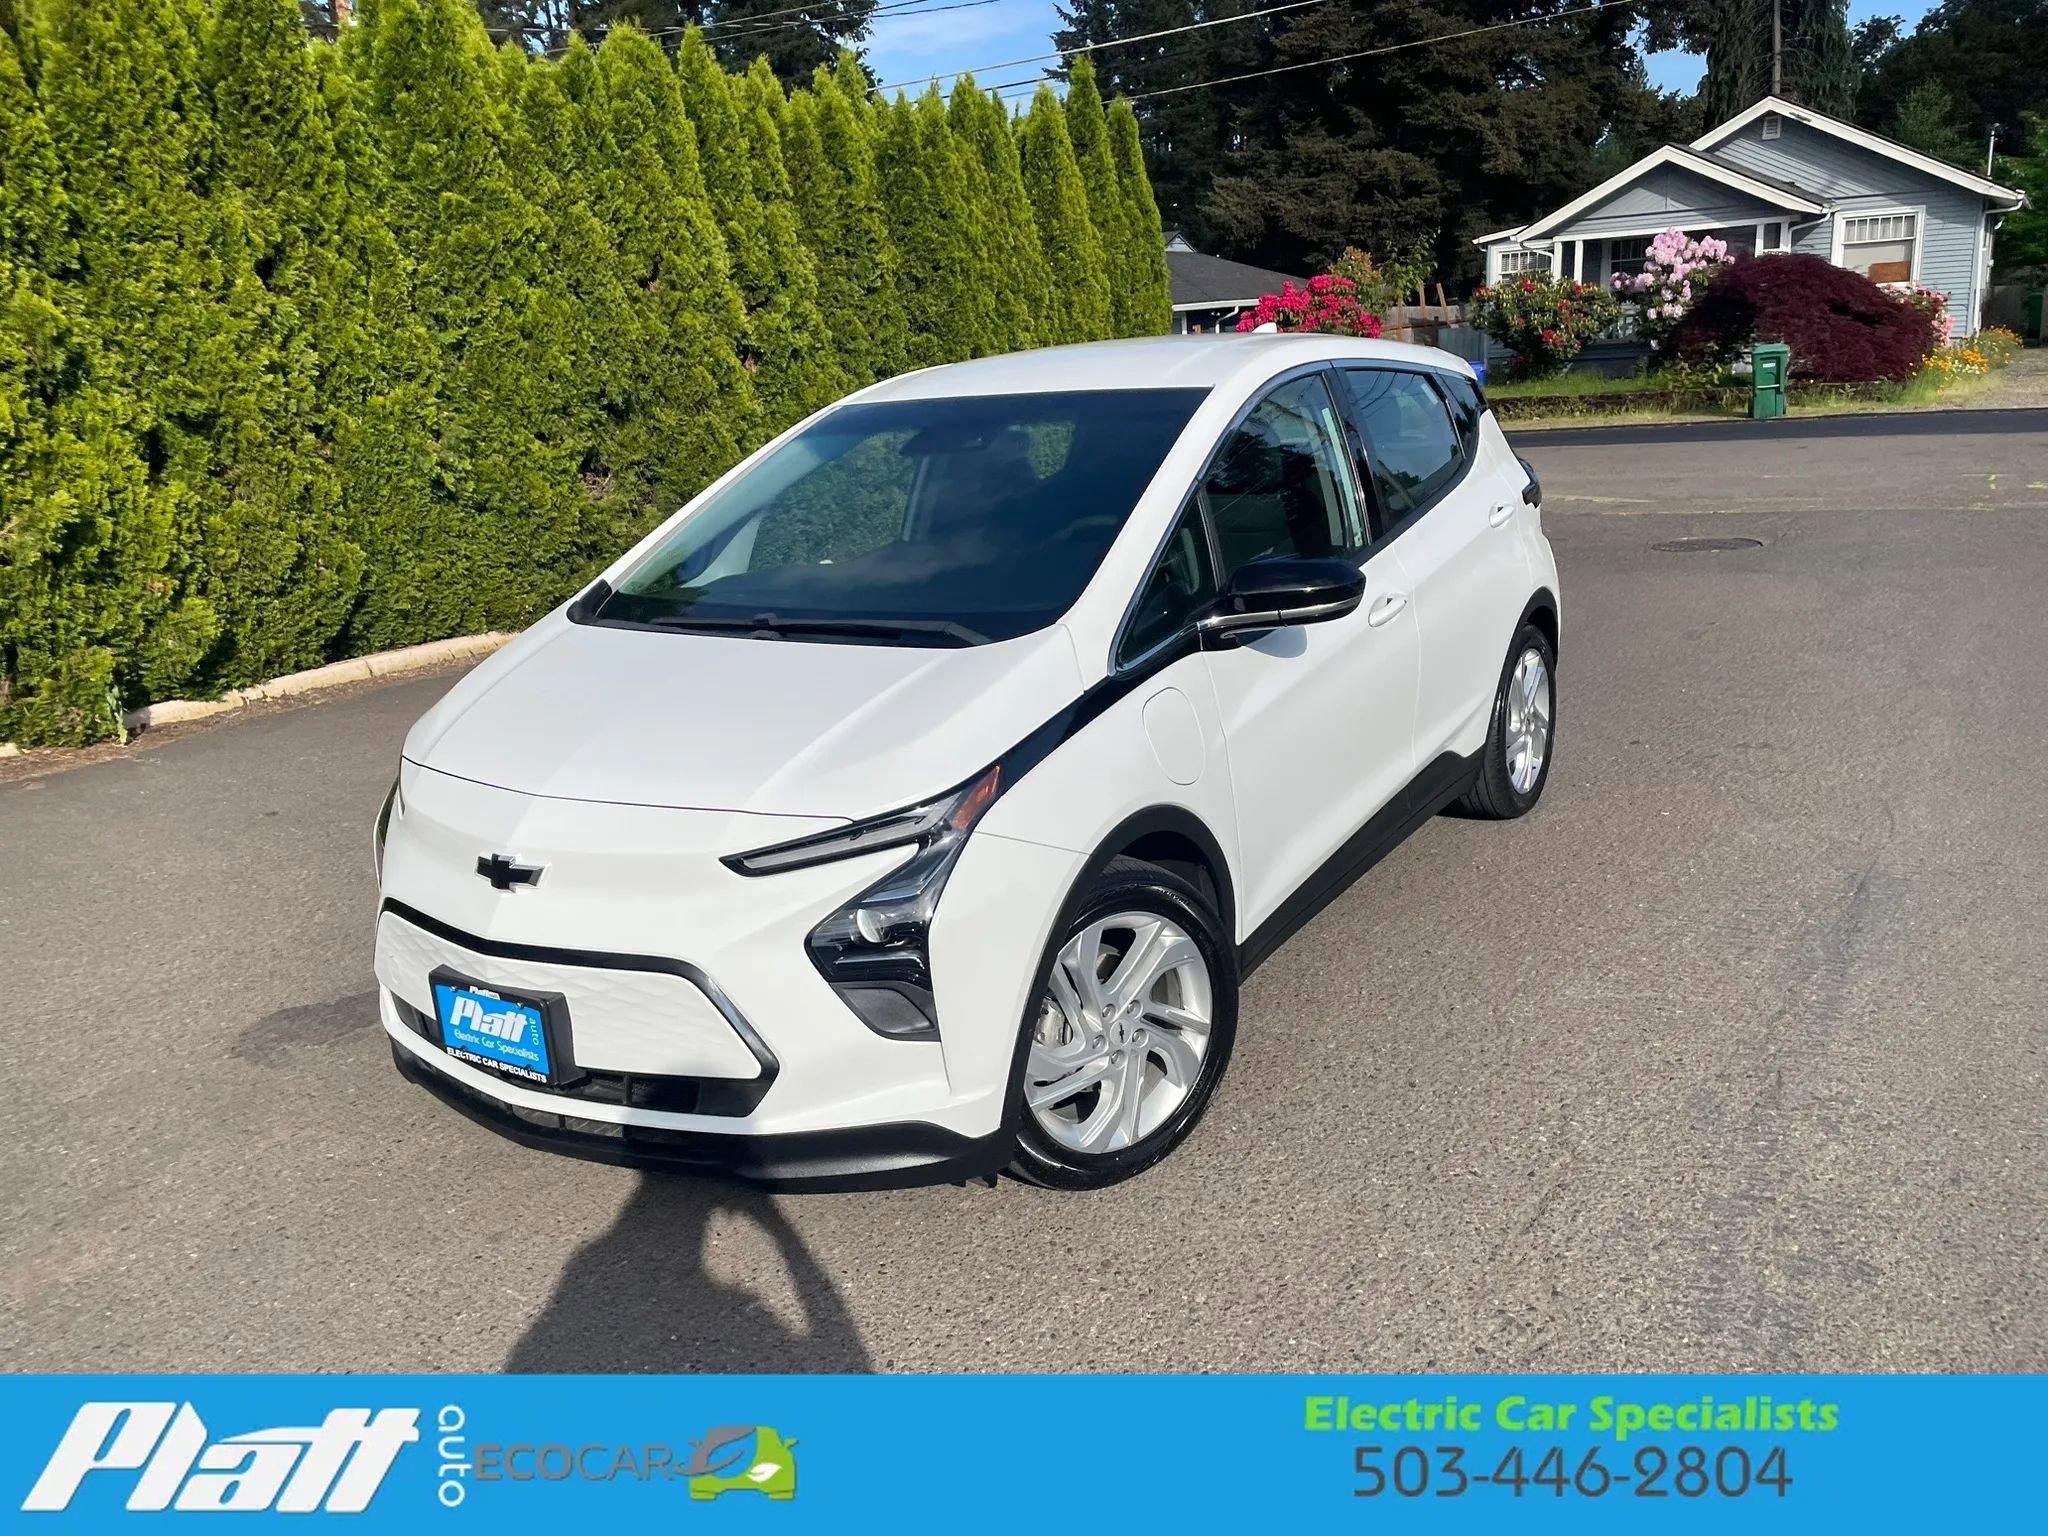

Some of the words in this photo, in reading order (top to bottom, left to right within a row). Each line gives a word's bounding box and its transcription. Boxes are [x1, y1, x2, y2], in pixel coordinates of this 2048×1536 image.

[450, 996, 528, 1042] Platt
[529, 1017, 539, 1046] auto
[446, 1046, 482, 1064] ELECTRIC
[482, 1057, 499, 1069] CAR
[499, 1062, 547, 1083] SPECIALISTS
